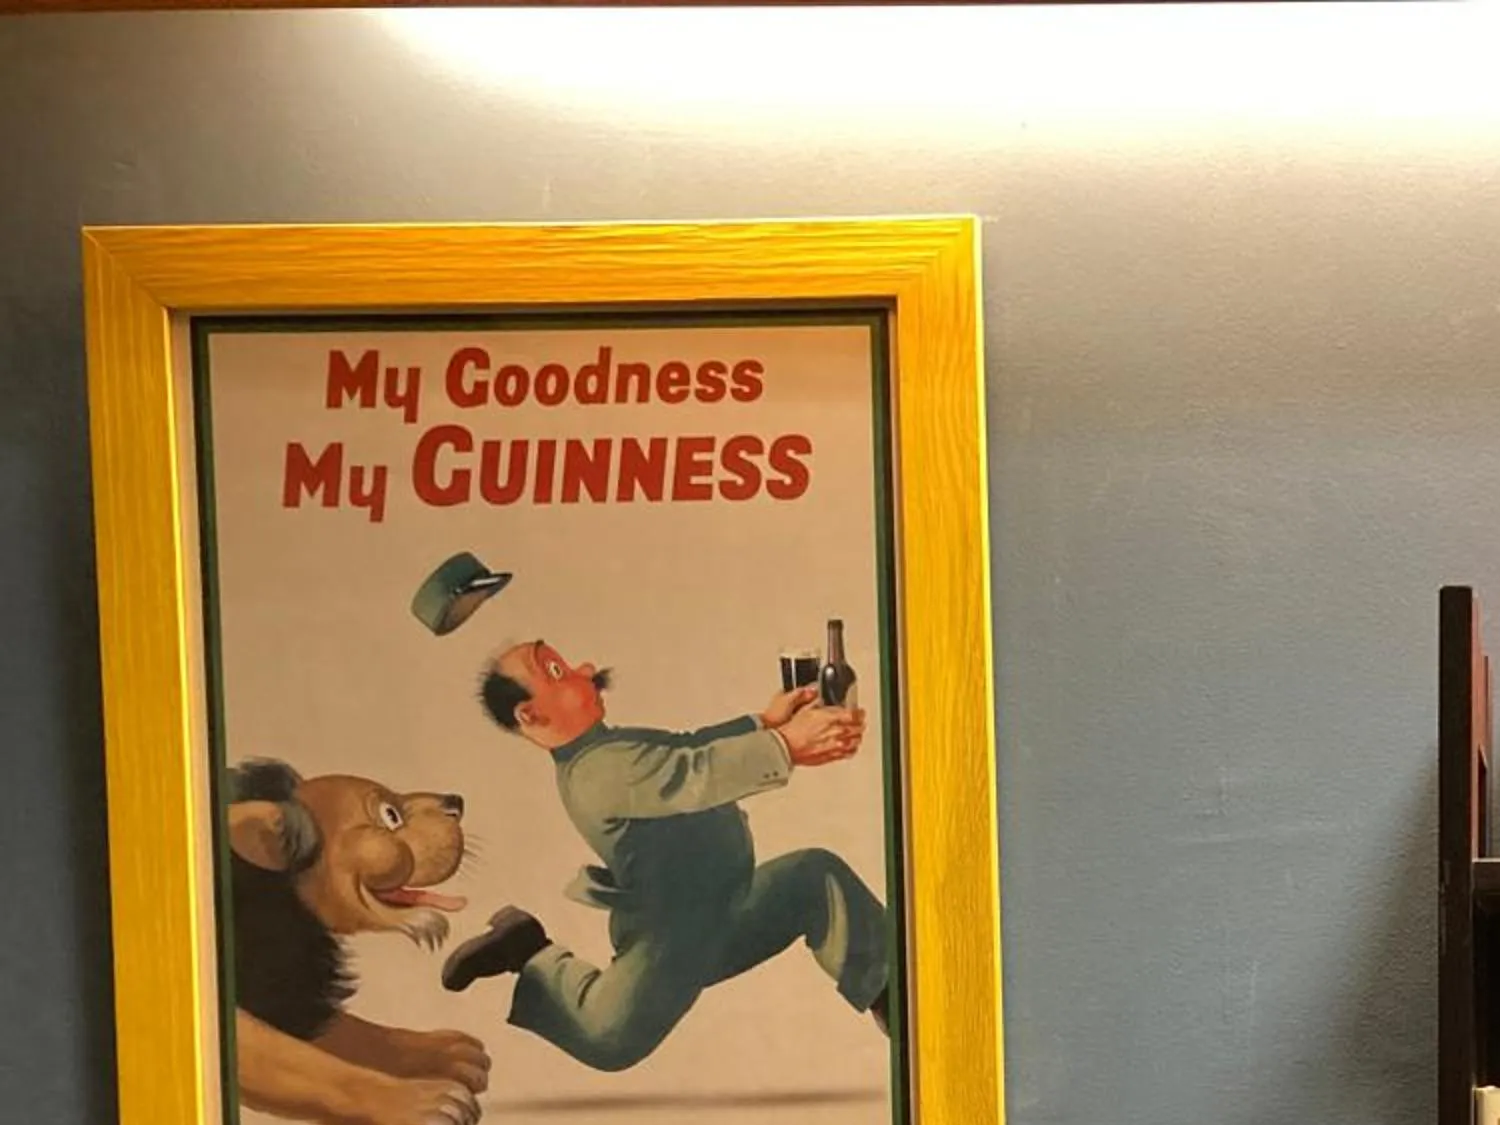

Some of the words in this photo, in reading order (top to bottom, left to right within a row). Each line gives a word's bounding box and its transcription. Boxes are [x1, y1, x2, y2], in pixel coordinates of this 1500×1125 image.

[326, 349, 421, 423] My
[445, 346, 764, 409] Goodness
[282, 442, 388, 523] My
[412, 424, 812, 507] GUINNESS
